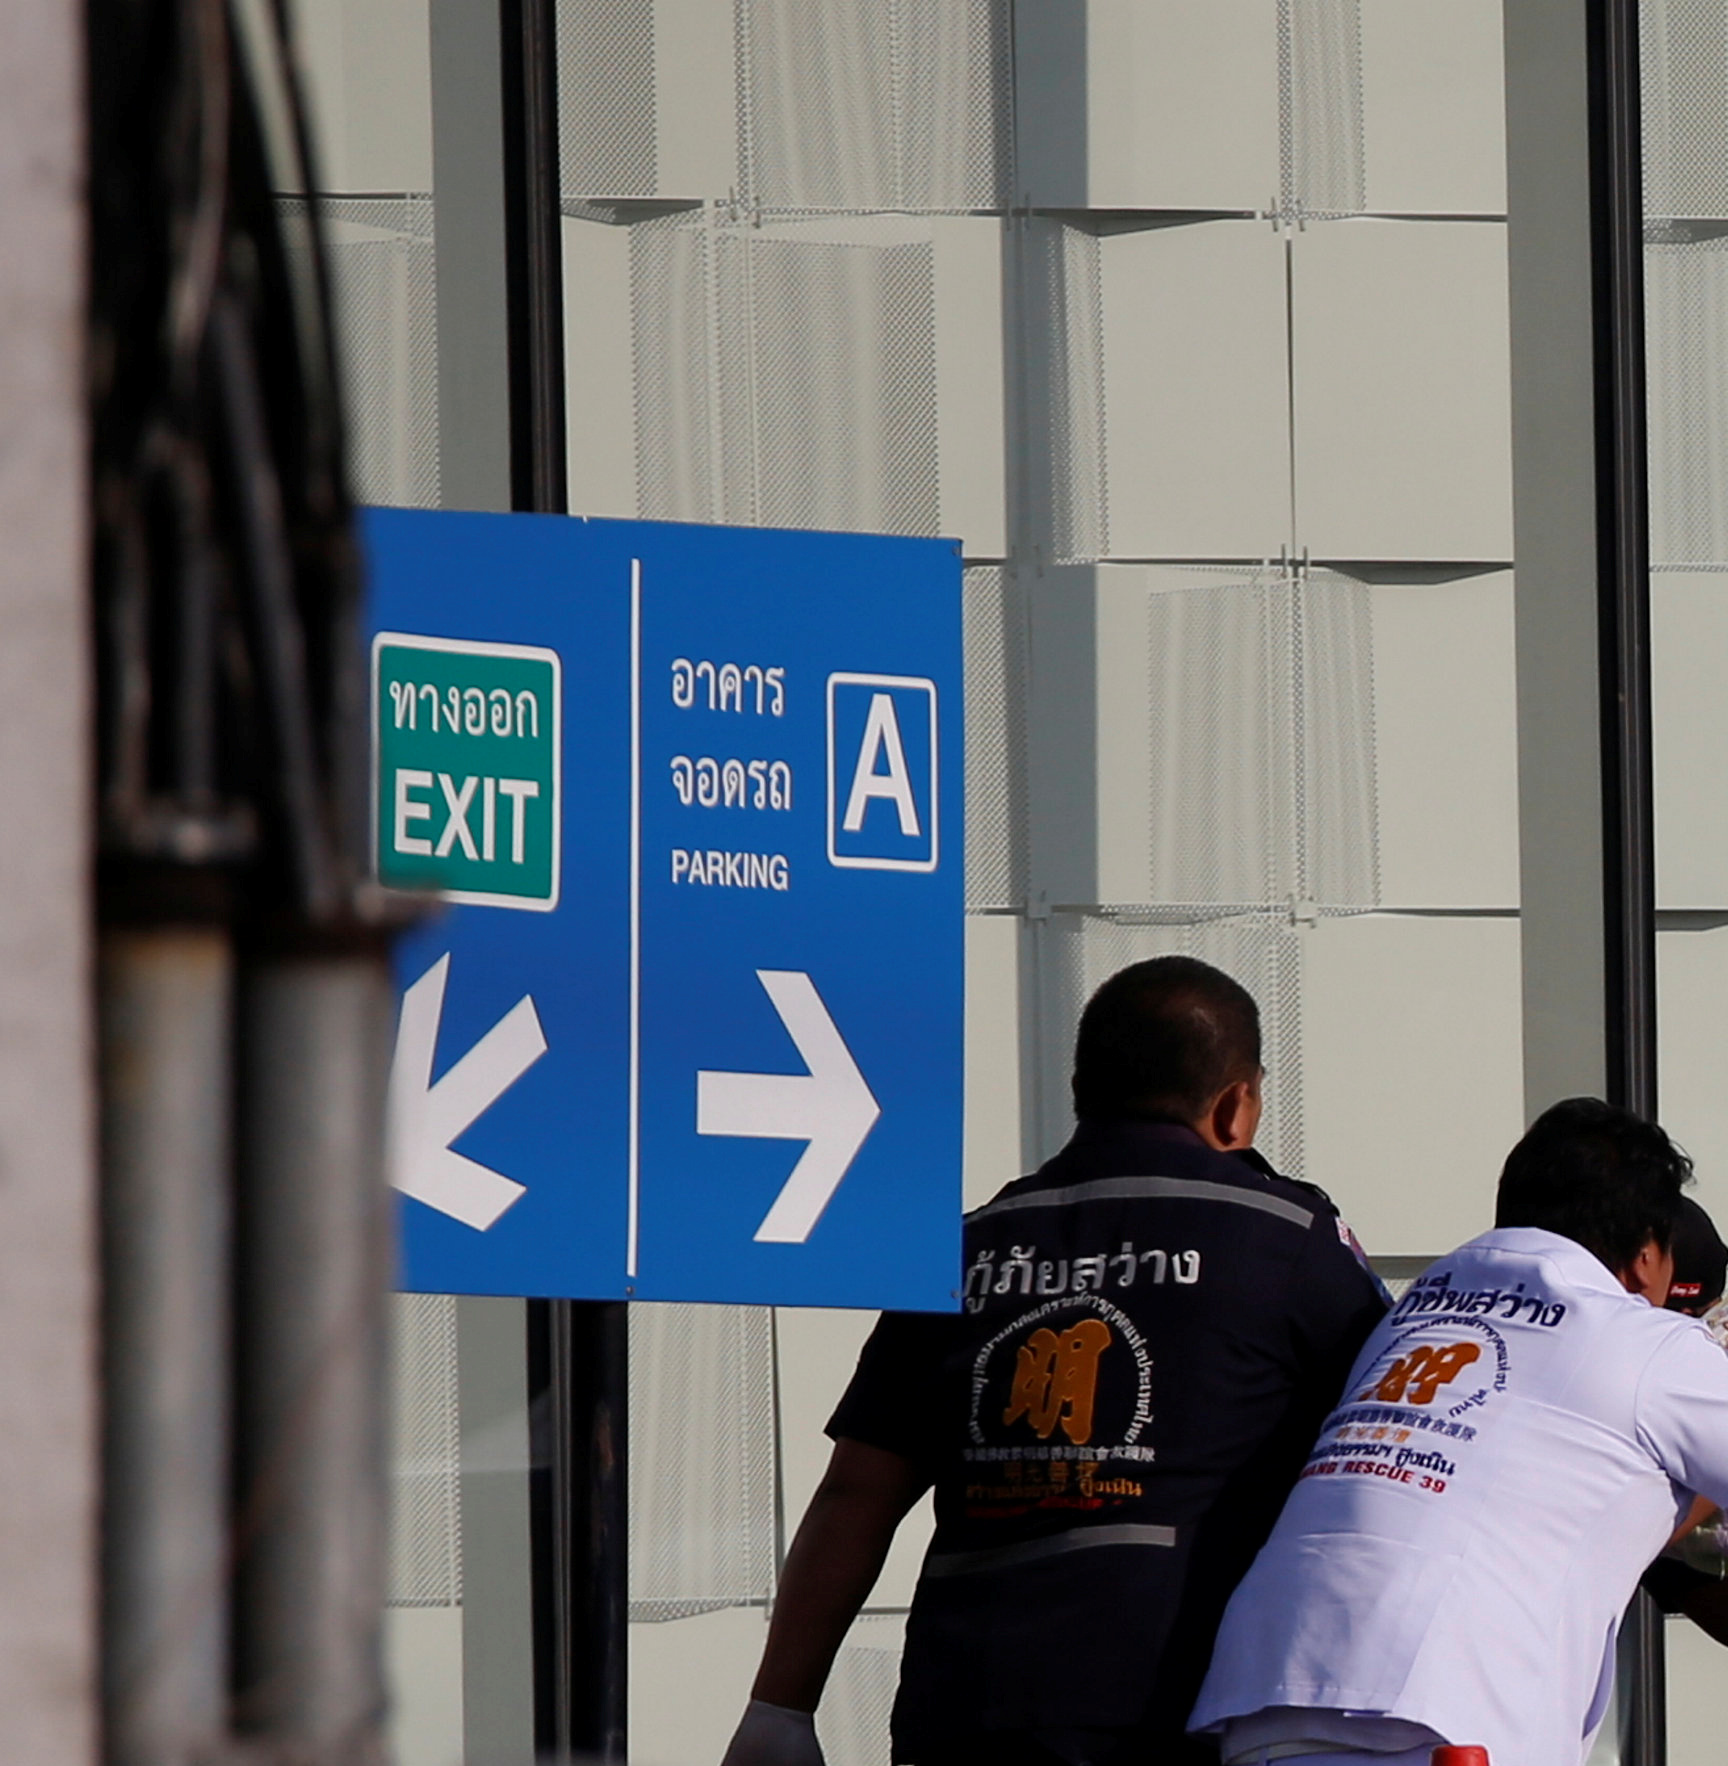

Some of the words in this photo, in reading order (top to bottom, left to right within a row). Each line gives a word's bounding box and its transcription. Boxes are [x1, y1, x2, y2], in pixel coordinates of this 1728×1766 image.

[388, 678, 540, 740] ทางออก
[670, 656, 787, 718] อาคาร
[670, 754, 792, 811] จอดรถ
[843, 693, 921, 837] A
[394, 768, 539, 864] EXIT
[671, 849, 789, 891] PARKING
[1342, 1461, 1415, 1485] RESCUE
[1418, 1475, 1447, 1494] 39
